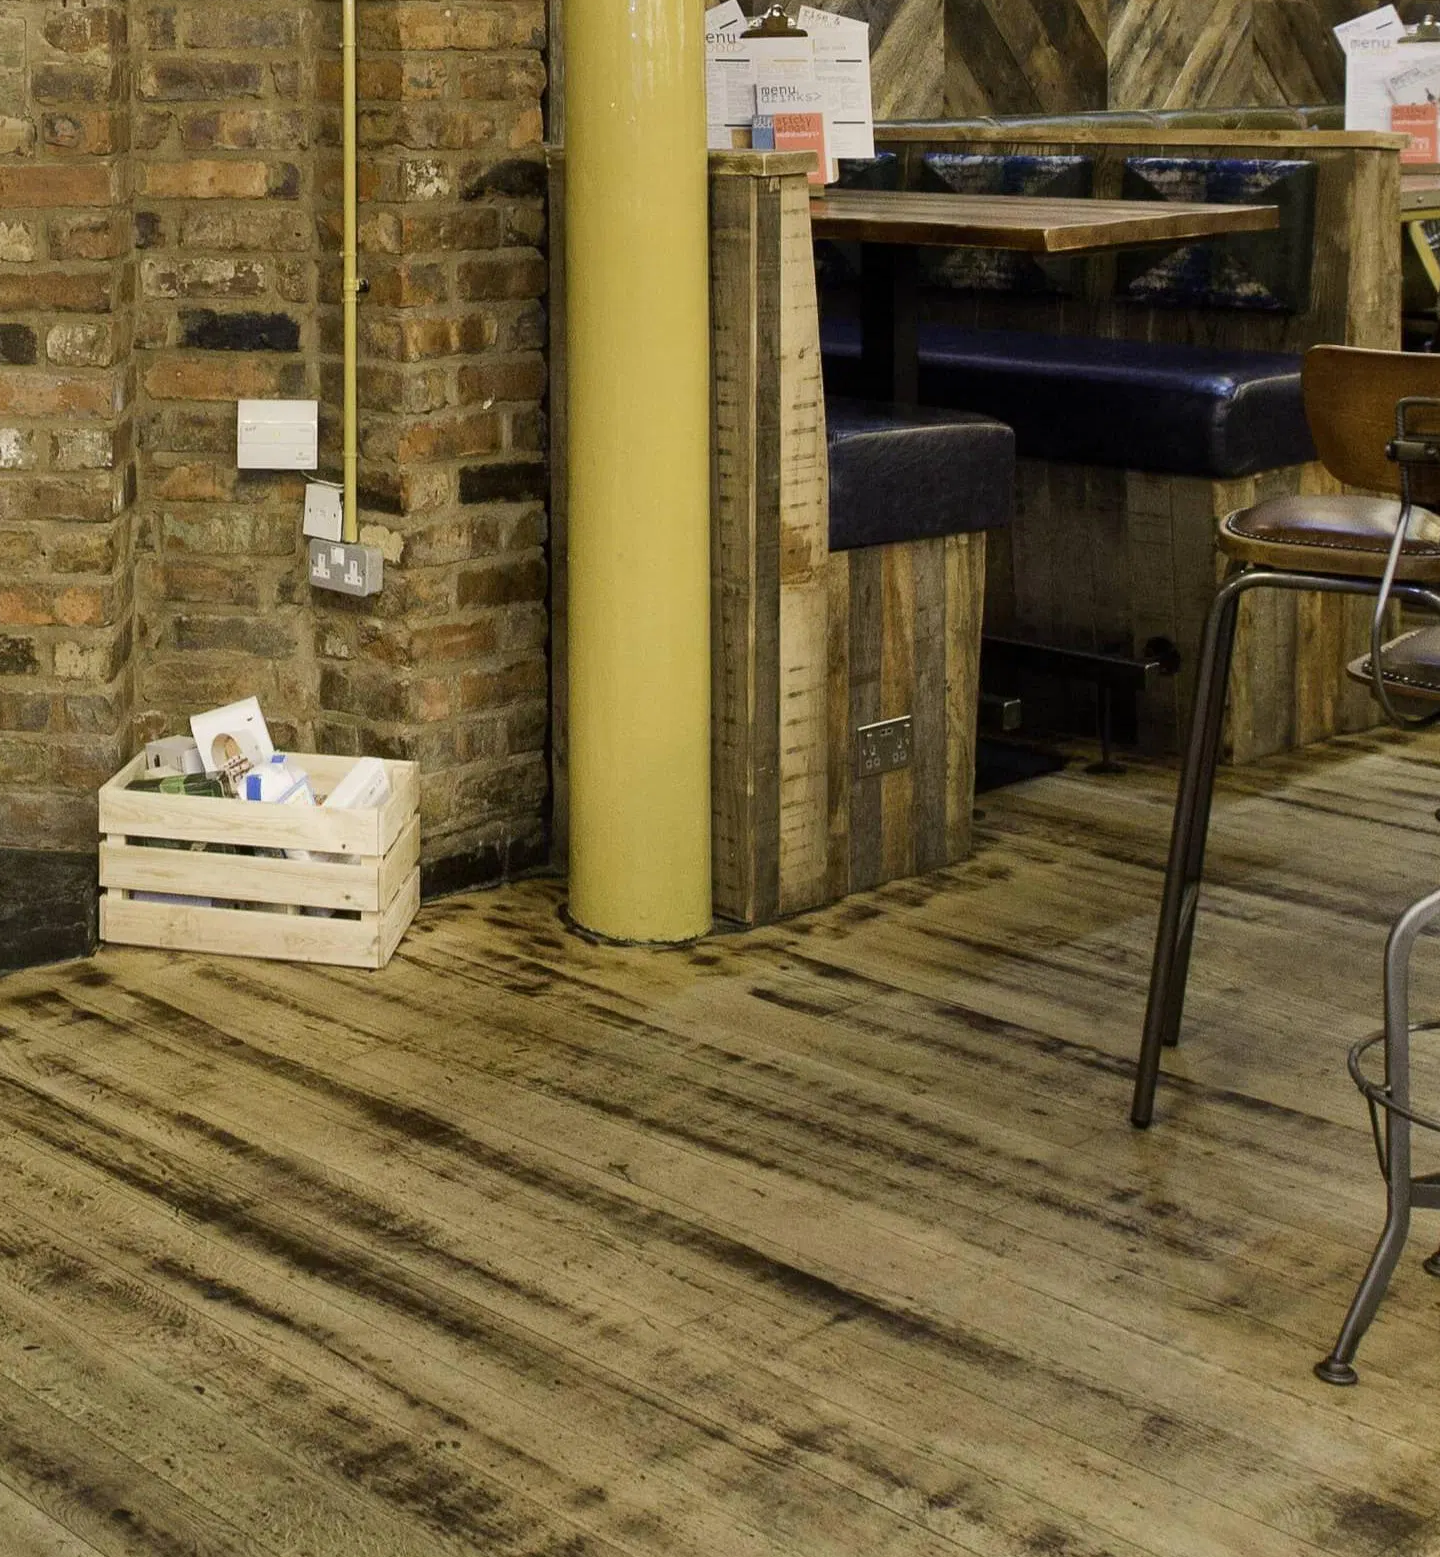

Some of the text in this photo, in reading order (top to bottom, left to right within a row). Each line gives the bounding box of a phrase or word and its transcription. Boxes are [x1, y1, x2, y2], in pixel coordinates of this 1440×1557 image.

[706, 32, 736, 45] enu
[1350, 38, 1391, 49] menu
[761, 85, 796, 96] menu
